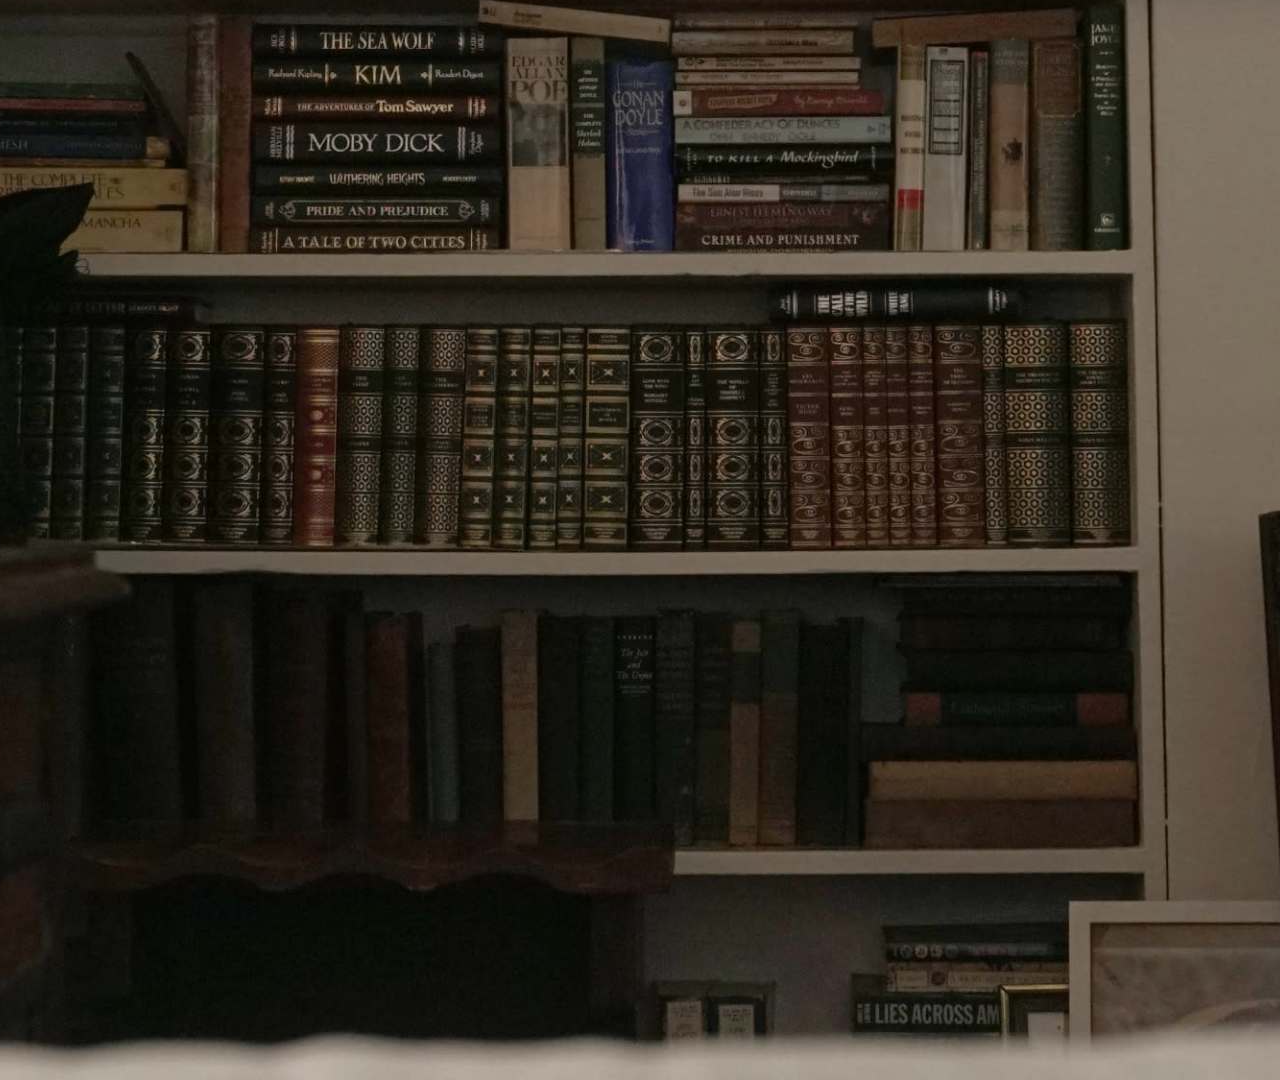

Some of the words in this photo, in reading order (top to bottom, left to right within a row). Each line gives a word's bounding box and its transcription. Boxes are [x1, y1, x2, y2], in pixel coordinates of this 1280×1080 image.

[320, 31, 355, 50] THE
[357, 31, 390, 50] SEA
[390, 31, 437, 50] WOLF
[511, 55, 567, 68] EDGAR
[353, 64, 403, 86] KIM
[511, 67, 567, 80] ALLAN
[510, 79, 568, 102] POE
[374, 99, 405, 113] Tom
[404, 100, 455, 115] Sawyer
[612, 90, 665, 108] CONAN
[614, 109, 664, 126] DOYLE
[694, 119, 773, 131] CONFEDERACY
[307, 132, 379, 153] MOBY
[385, 132, 446, 153] DICK
[707, 154, 723, 163] TO
[727, 153, 760, 164] KILL
[766, 154, 774, 163] A
[779, 150, 859, 169] Mockingbird
[0, 172, 29, 186] THE
[329, 172, 385, 186] WUTHERING
[386, 172, 427, 186] HEIGHTS
[306, 205, 345, 217] PRIDE
[348, 205, 377, 217] AND
[379, 205, 449, 217] PREJUDICE
[280, 236, 297, 249] A
[297, 235, 343, 249] TALE
[345, 235, 368, 249] OF
[368, 235, 409, 249] TWO
[410, 235, 466, 250] CITIES
[700, 234, 744, 246] CRIME
[747, 234, 774, 246] AND
[777, 233, 860, 246] PUNISHMENT
[875, 1002, 909, 1025] LIES
[911, 1002, 973, 1025] ACROSS
